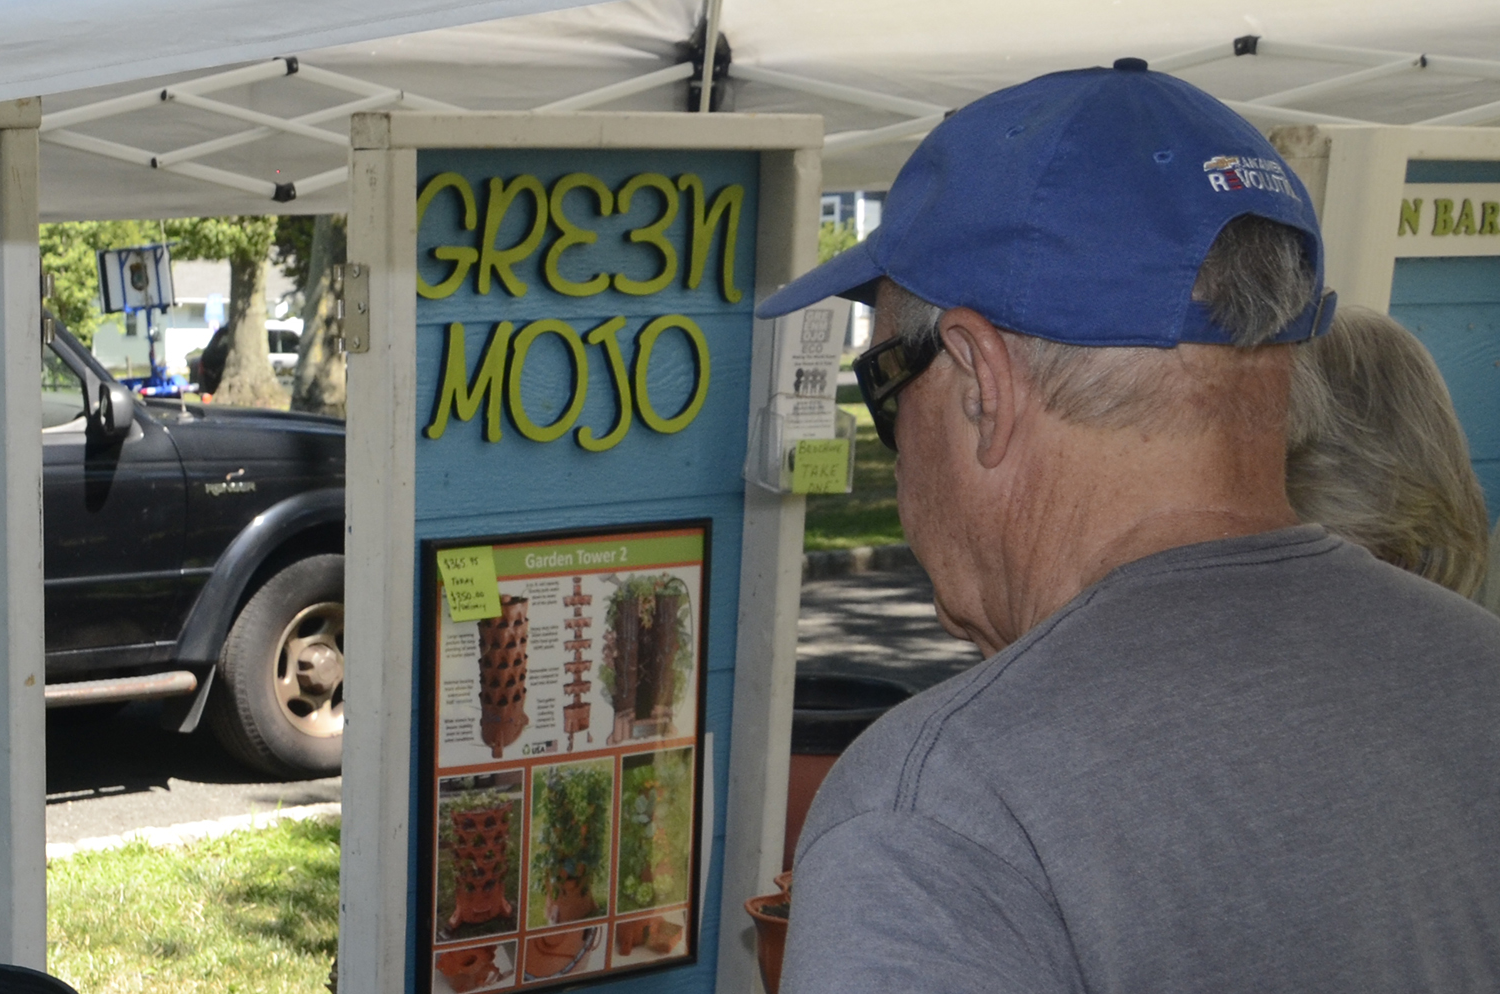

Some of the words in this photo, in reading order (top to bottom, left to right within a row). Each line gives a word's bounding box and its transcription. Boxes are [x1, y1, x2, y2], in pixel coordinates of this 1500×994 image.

[427, 314, 710, 453] MOJO
[525, 551, 573, 569] Garden
[576, 549, 616, 566] Tower
[620, 546, 628, 562] 2
[531, 745, 545, 755] USA
